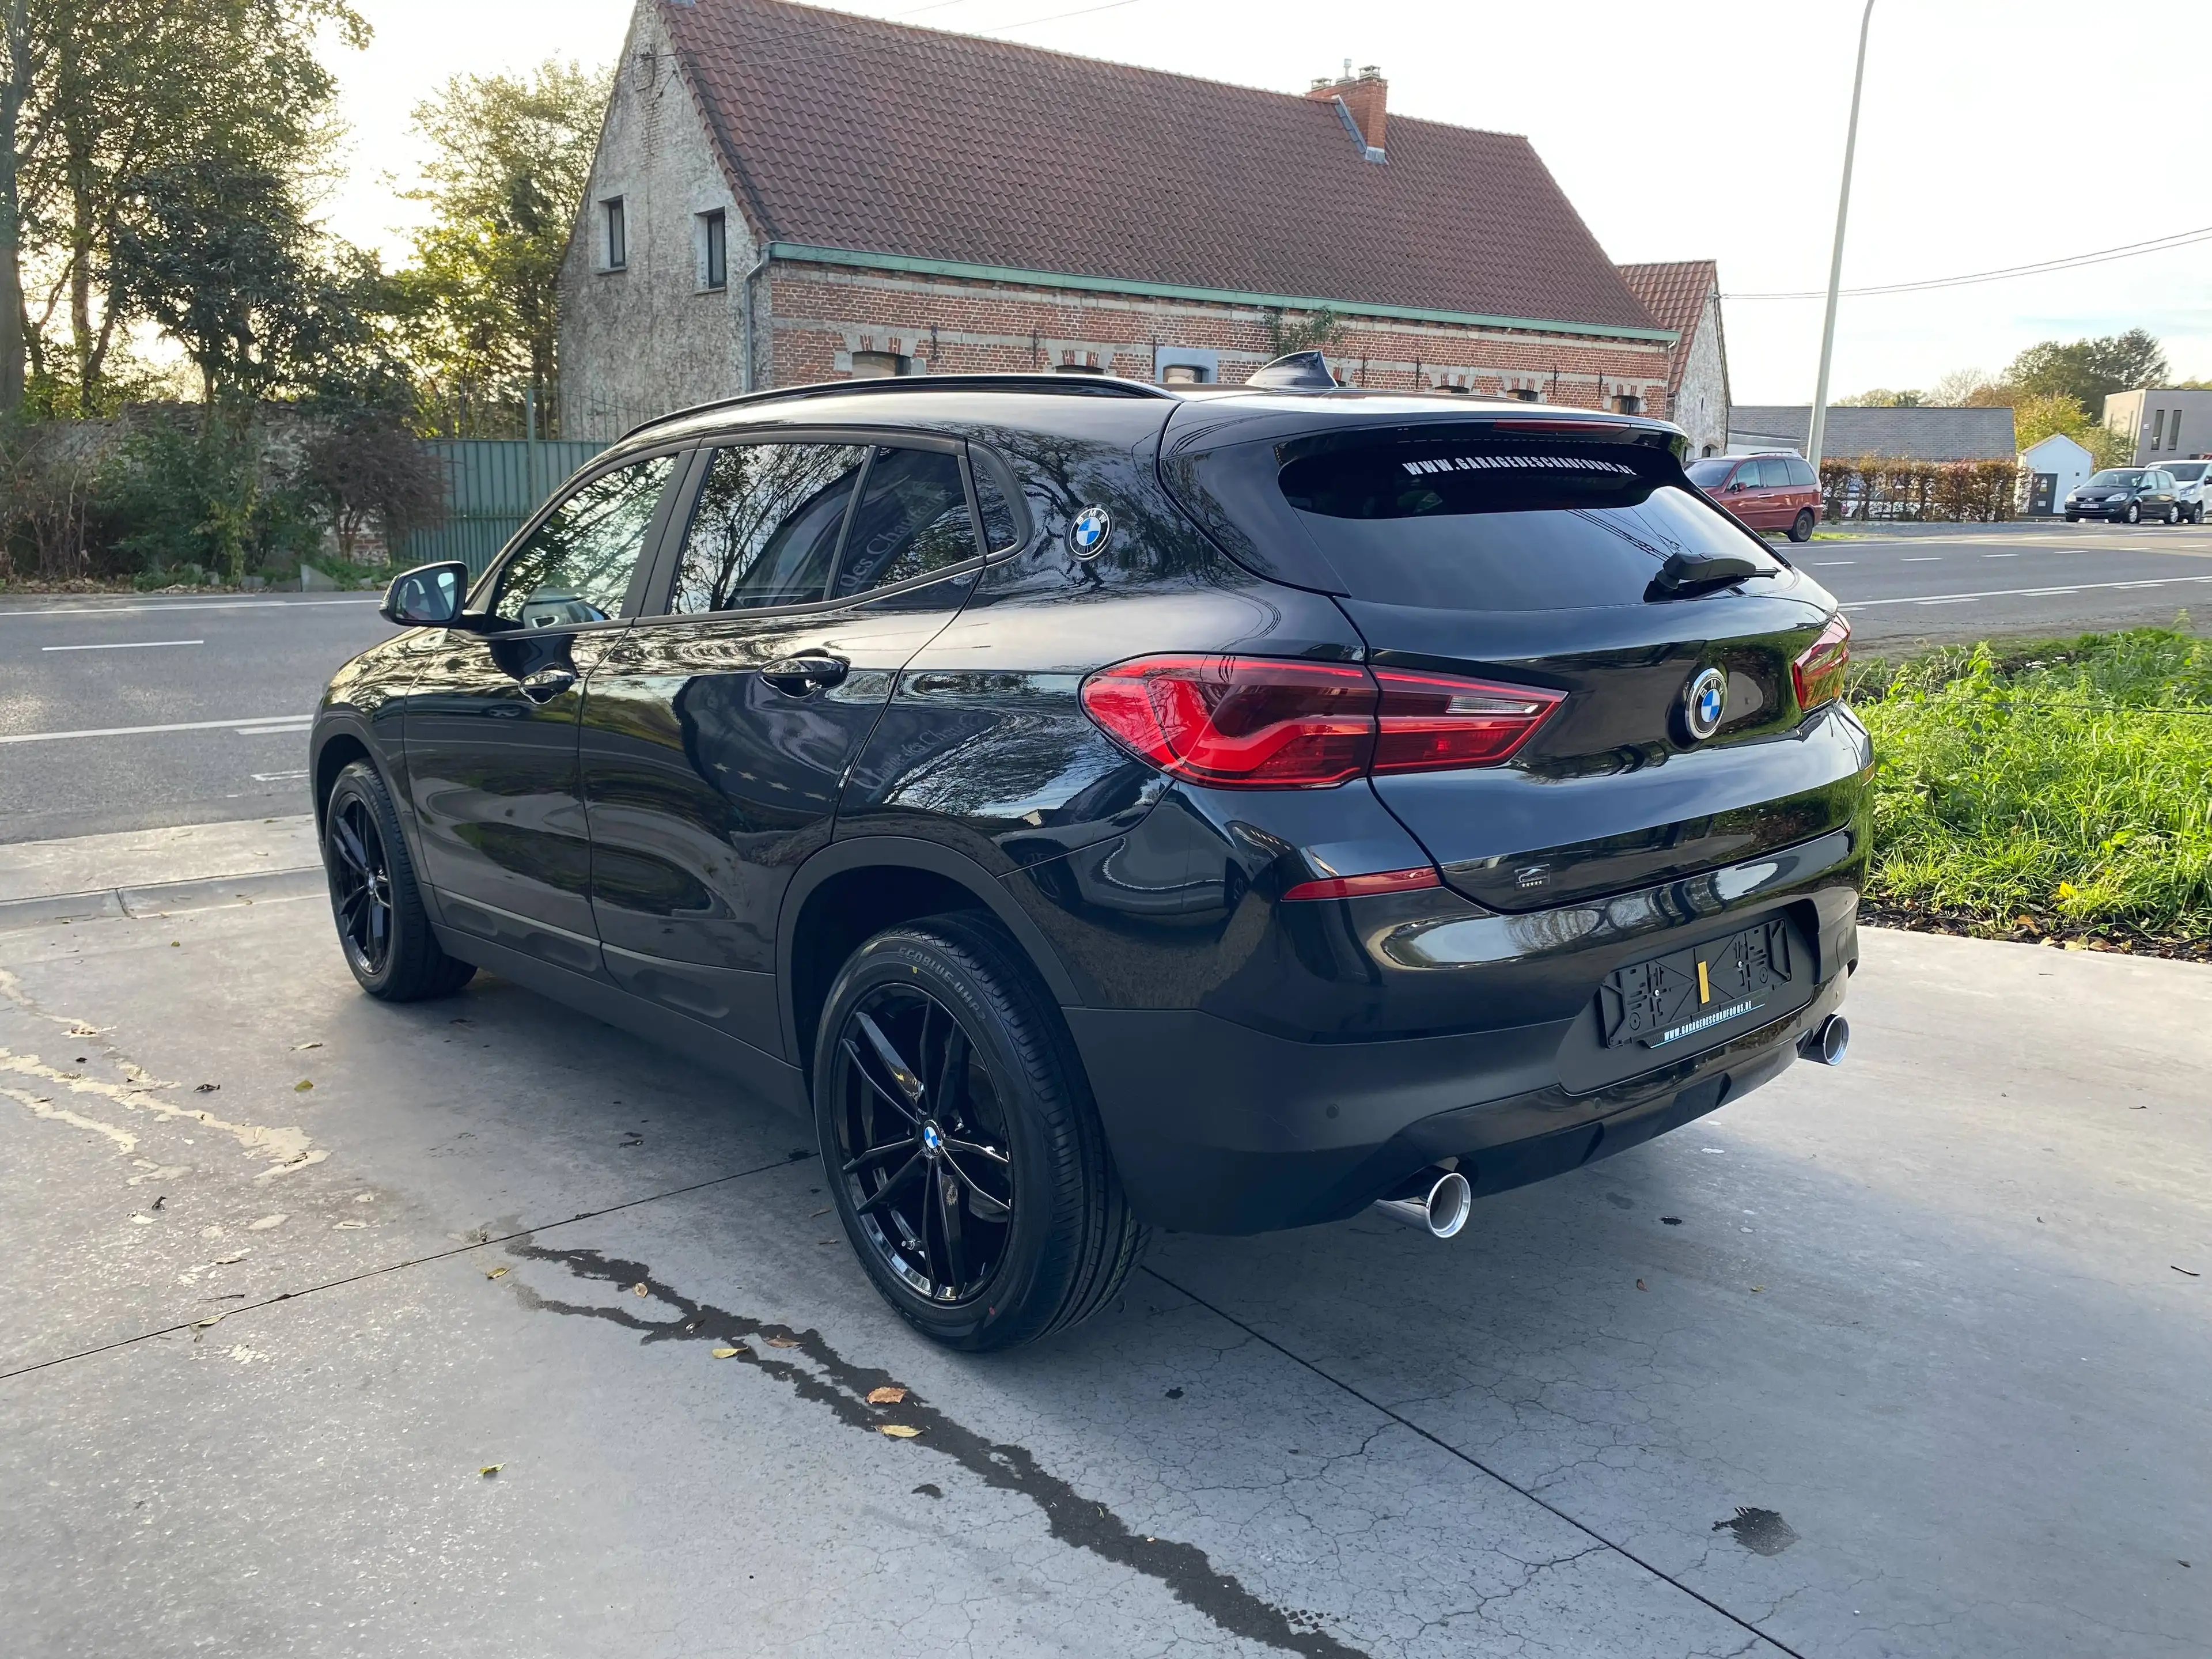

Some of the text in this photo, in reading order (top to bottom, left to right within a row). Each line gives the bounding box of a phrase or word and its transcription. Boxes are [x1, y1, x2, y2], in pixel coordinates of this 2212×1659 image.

[1076, 510, 1107, 525] BMW
[1699, 680, 1724, 698] BMW
[897, 947, 954, 983] ECOBLUE
